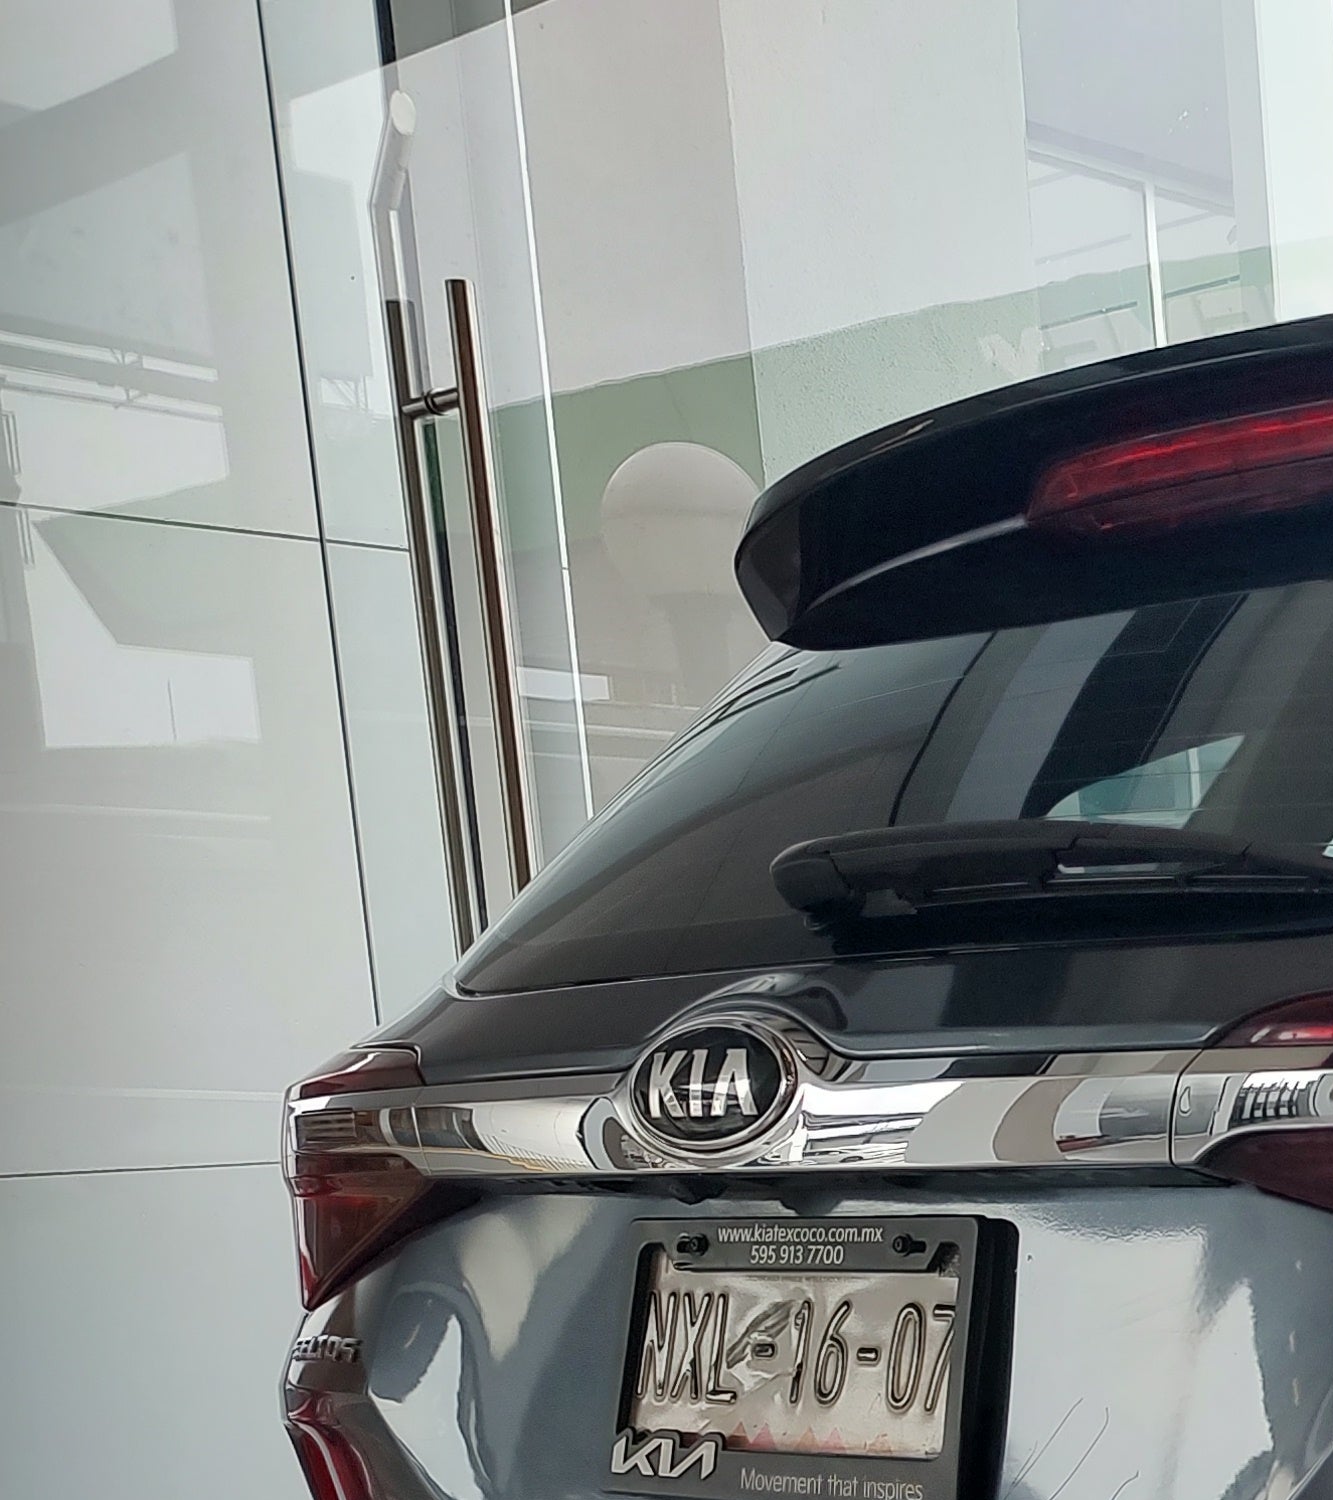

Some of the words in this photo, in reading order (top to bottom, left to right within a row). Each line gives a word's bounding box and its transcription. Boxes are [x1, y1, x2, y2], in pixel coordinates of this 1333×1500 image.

[648, 1048, 759, 1118] KIA
[717, 1223, 884, 1243] www.kiatexcoco.com.mx
[750, 1245, 777, 1265] 595
[779, 1245, 803, 1265] 913
[806, 1245, 844, 1265] 7700
[610, 1435, 717, 1480] KIA
[740, 1467, 823, 1494] Movement
[827, 1474, 858, 1497] that
